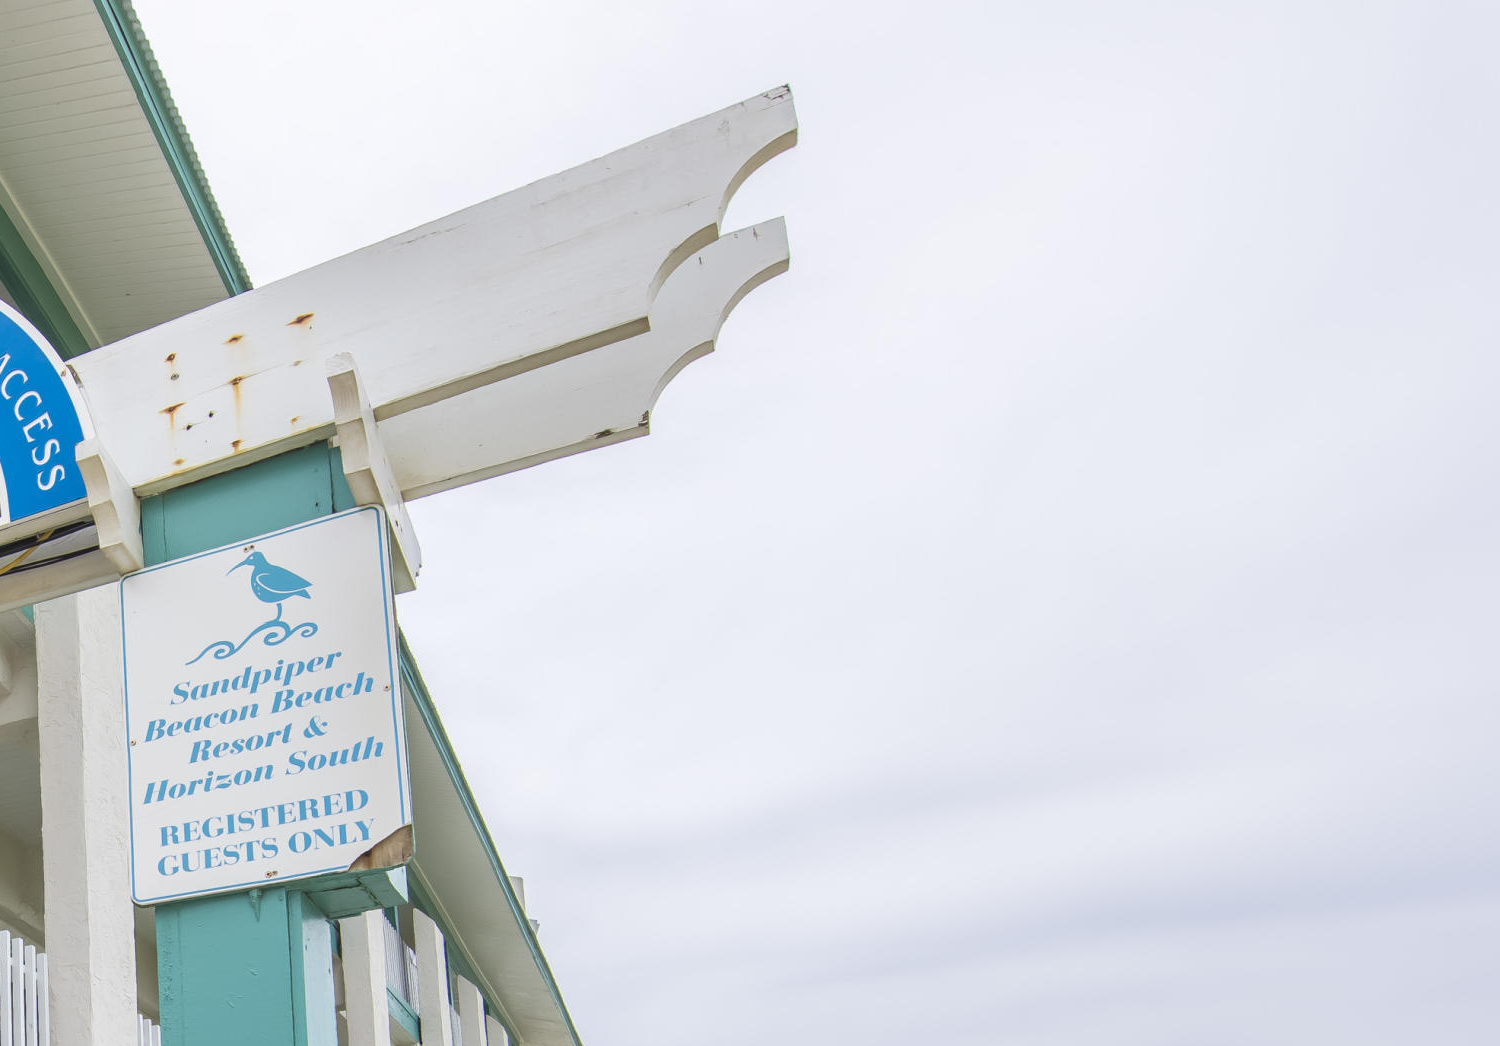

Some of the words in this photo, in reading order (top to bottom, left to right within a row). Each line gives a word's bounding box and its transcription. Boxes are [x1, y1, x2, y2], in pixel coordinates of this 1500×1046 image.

[144, 702, 260, 743] Beacon
[270, 671, 375, 714] Beach
[169, 651, 342, 705] Sandpiper
[189, 722, 293, 764] Resort
[303, 715, 329, 739] &
[143, 764, 274, 805] Horizon
[284, 736, 384, 776] South
[159, 788, 370, 847] REGISTERED
[157, 837, 279, 877] GUESTS
[288, 818, 375, 854] ONLY
